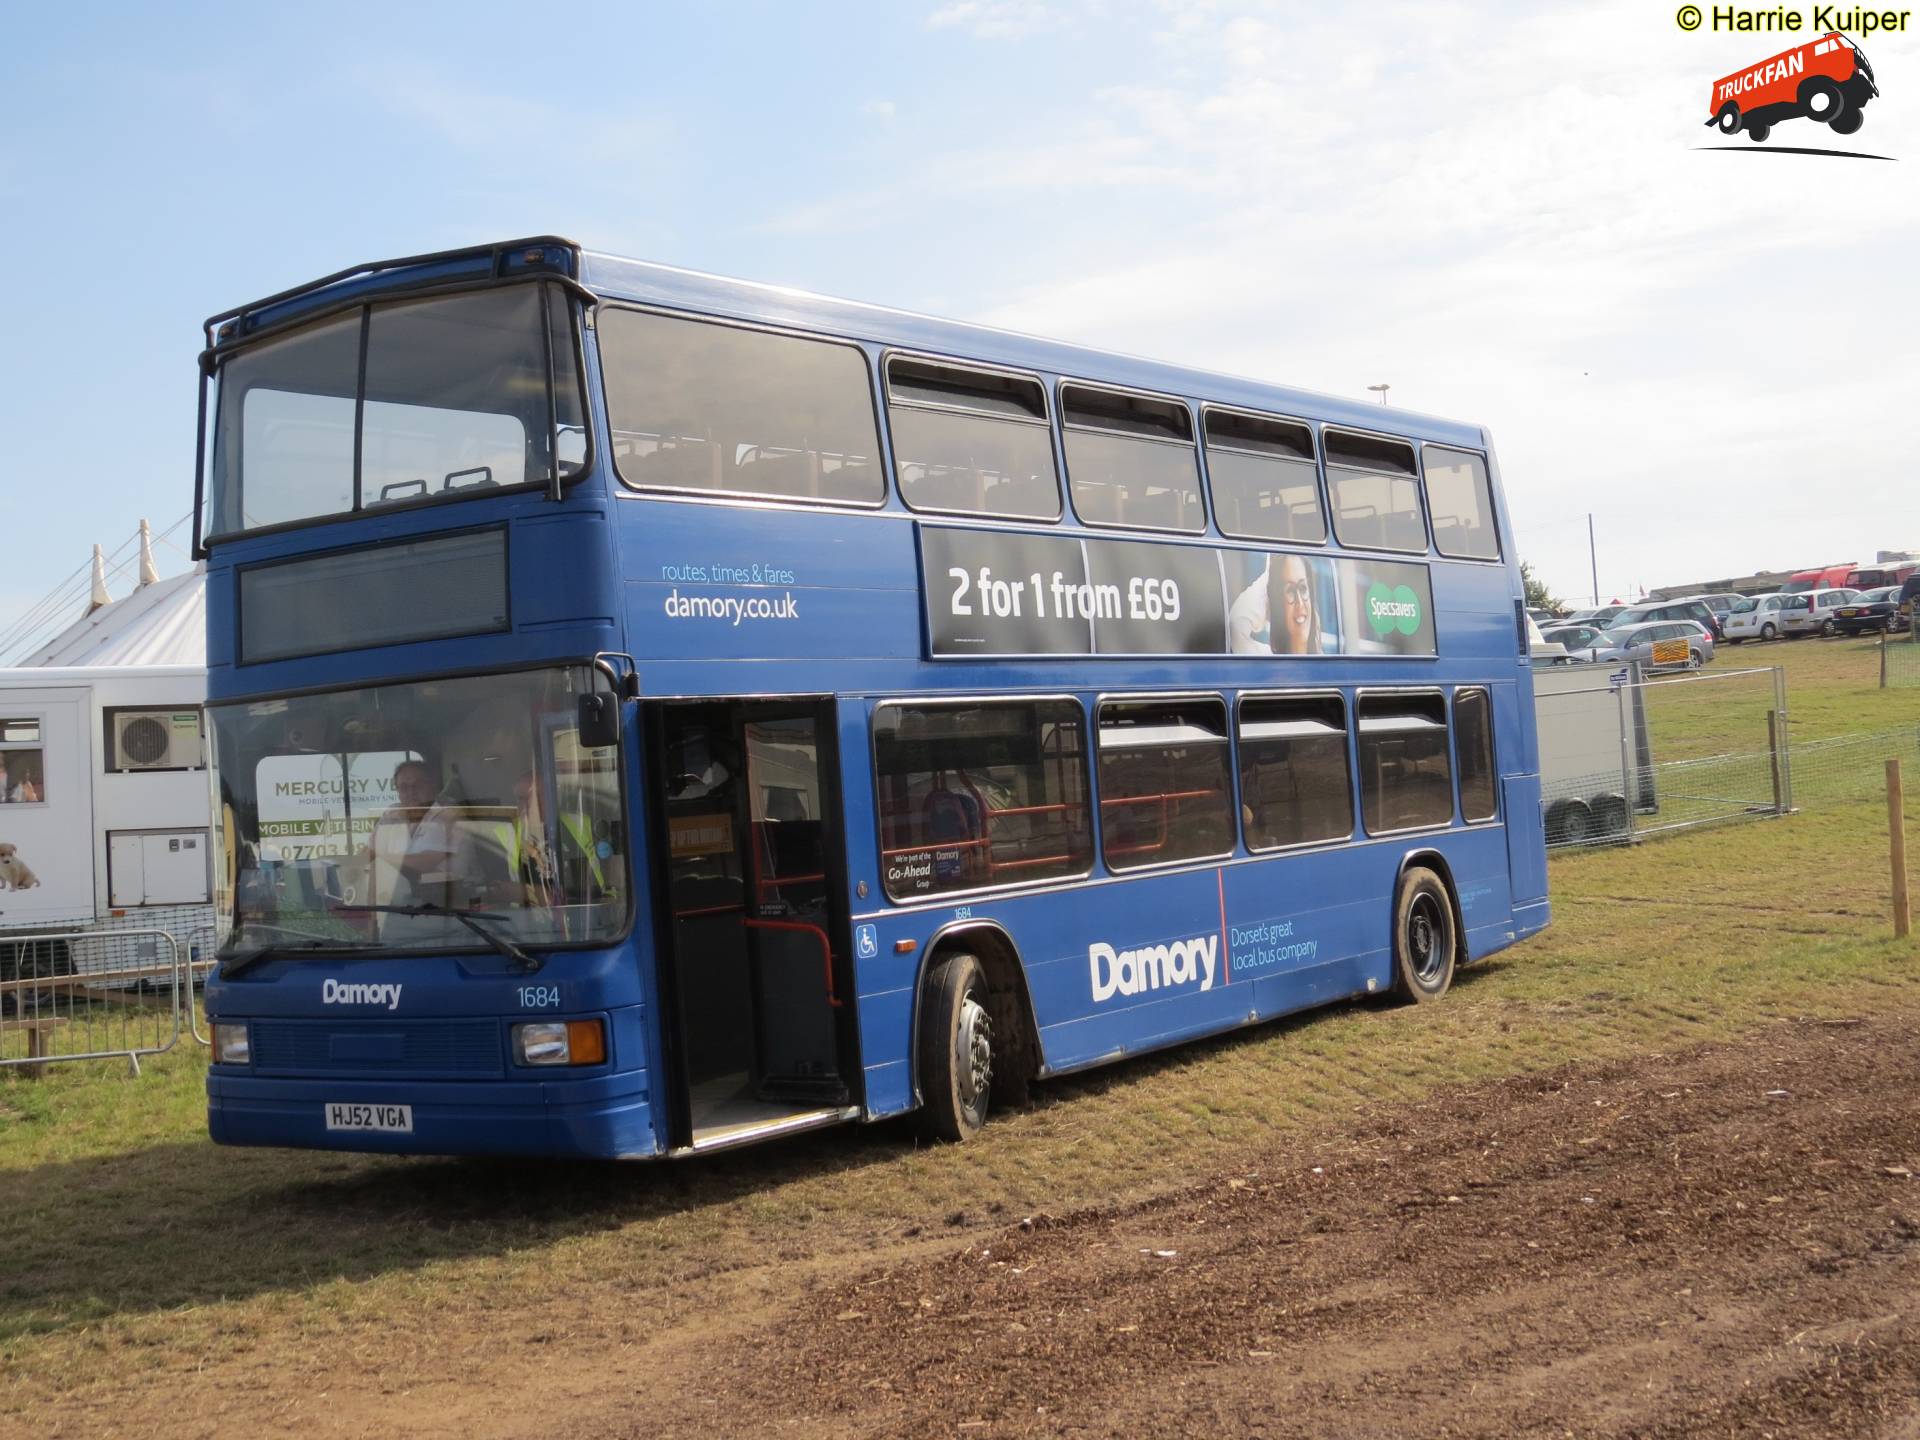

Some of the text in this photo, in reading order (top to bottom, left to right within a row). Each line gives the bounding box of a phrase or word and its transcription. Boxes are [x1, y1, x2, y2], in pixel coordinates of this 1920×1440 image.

[662, 563, 795, 584] routes, times & fares
[949, 567, 1181, 621] 2 for 1 from £69
[665, 588, 799, 626] damory.co.uk
[1370, 597, 1416, 620] Specsavers
[275, 779, 369, 796] MERCURY
[888, 863, 931, 880] Go-Ahead
[1231, 919, 1294, 947] Dorset's great
[1233, 940, 1318, 970] local bus company
[1089, 934, 1217, 1002] Damory
[323, 978, 402, 1010] Damory
[516, 986, 560, 1007] 1684
[332, 1106, 407, 1128] HJ52 VGA
